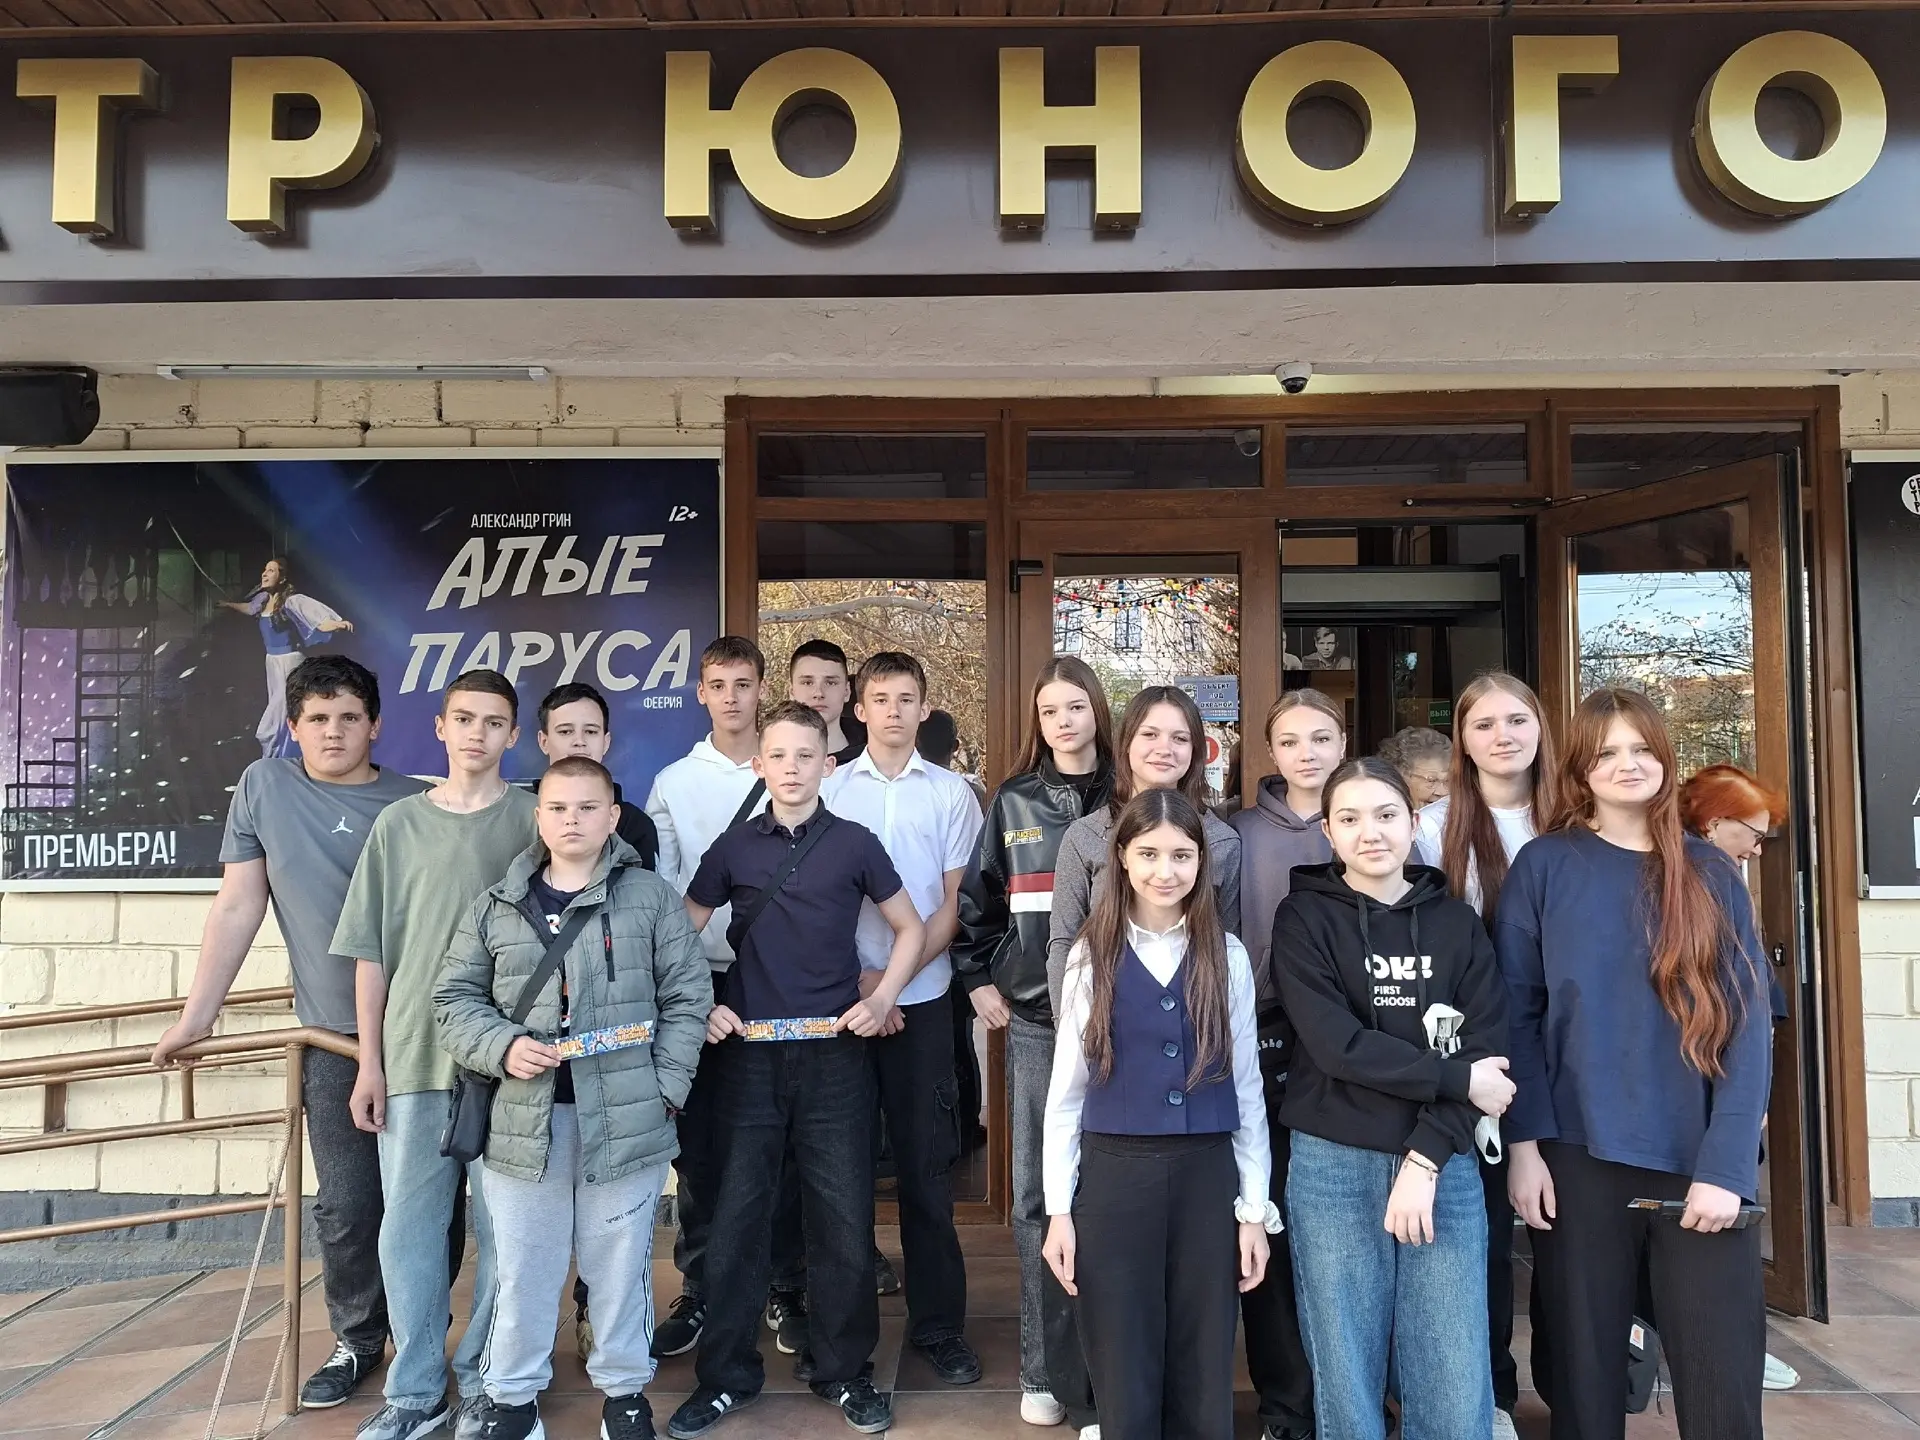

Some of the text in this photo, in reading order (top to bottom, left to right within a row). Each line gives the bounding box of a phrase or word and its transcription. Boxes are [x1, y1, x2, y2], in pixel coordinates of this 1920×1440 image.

[0, 30, 1888, 236] ТР ЮНОГО
[471, 513, 572, 529] АЛЕКСАНДР ГРИН
[669, 505, 699, 522] 12+
[426, 534, 666, 612] АЛЫЕ
[399, 628, 691, 694] ПАРУСА
[643, 696, 683, 709] ФЕЕРИЯ
[1430, 709, 1451, 717] ВЫХ
[24, 831, 177, 869] ПРЕМЬЕРА!
[1365, 953, 1433, 980] OK!
[1374, 985, 1401, 995] FIRST
[1374, 997, 1416, 1006] CHOOSE
